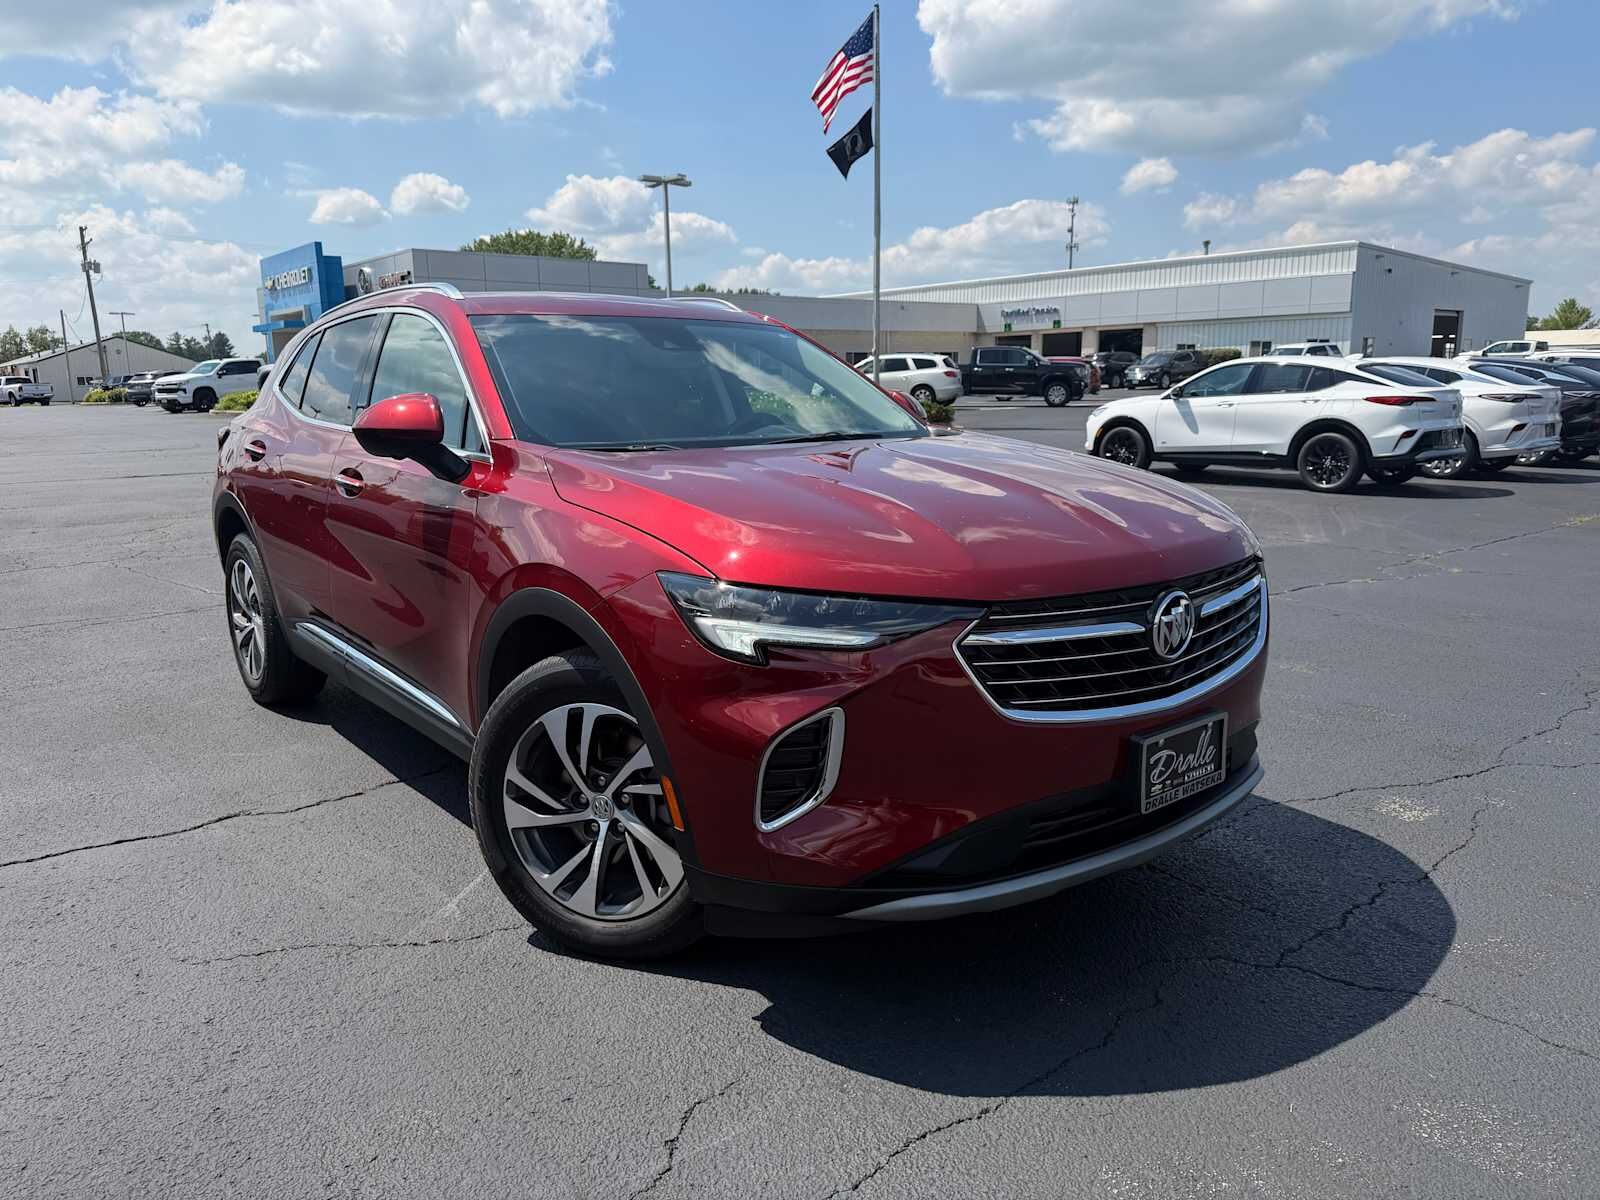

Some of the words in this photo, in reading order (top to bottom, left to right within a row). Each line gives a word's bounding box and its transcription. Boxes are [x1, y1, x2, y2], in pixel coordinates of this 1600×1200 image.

[275, 267, 308, 289] CHEVROLET
[1150, 727, 1216, 784] Dralle
[1145, 788, 1179, 811] DRALLE
[1181, 772, 1223, 796] WATSEKA
